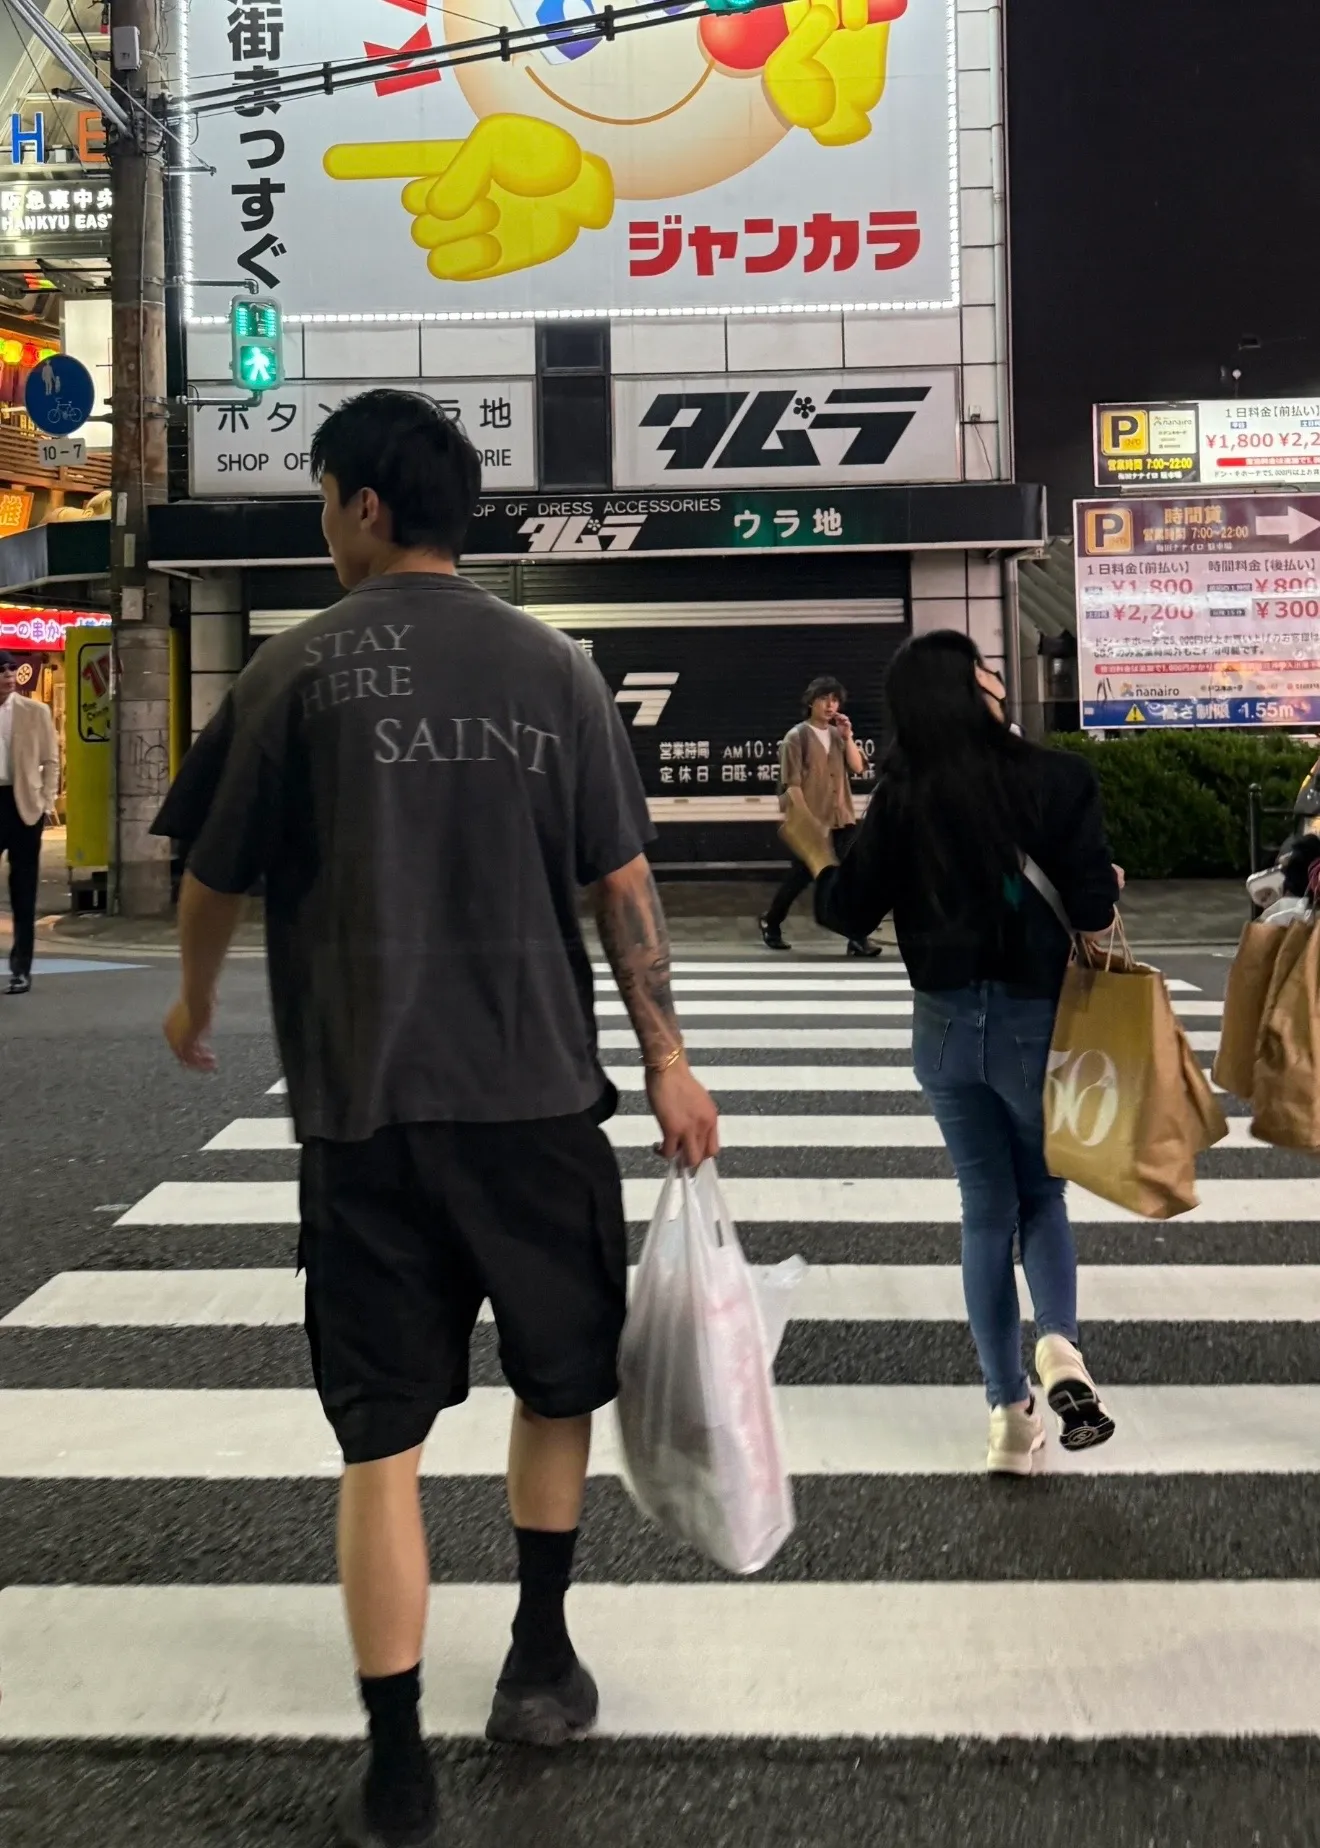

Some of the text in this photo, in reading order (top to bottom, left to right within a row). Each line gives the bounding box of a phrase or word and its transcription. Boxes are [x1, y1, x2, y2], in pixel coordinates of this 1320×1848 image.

[227, 0, 287, 290] 街まっすぐ
[1, 213, 112, 230] HANKYU EAS
[629, 210, 921, 277] ジャンカラ
[638, 386, 932, 471] タムラ
[1111, 415, 1139, 449] P
[1205, 433, 1274, 452] ¥1,800
[217, 453, 269, 472] SHOP
[283, 452, 310, 471] OF
[505, 503, 528, 516] OF
[538, 501, 593, 515] DRESS
[603, 498, 721, 514] ACCESSORIES
[734, 507, 843, 539] ウラ地
[517, 515, 648, 552] タムラ
[1095, 513, 1124, 548] P
[1112, 603, 1194, 624] ¥2,200
[304, 624, 415, 667] STAY
[302, 665, 414, 719] HERE
[1135, 684, 1180, 697] nanairo
[1241, 701, 1294, 720] 1.55m
[374, 717, 561, 775] SAINT
[659, 740, 710, 760] 営業時間
[659, 764, 710, 783] 定休日
